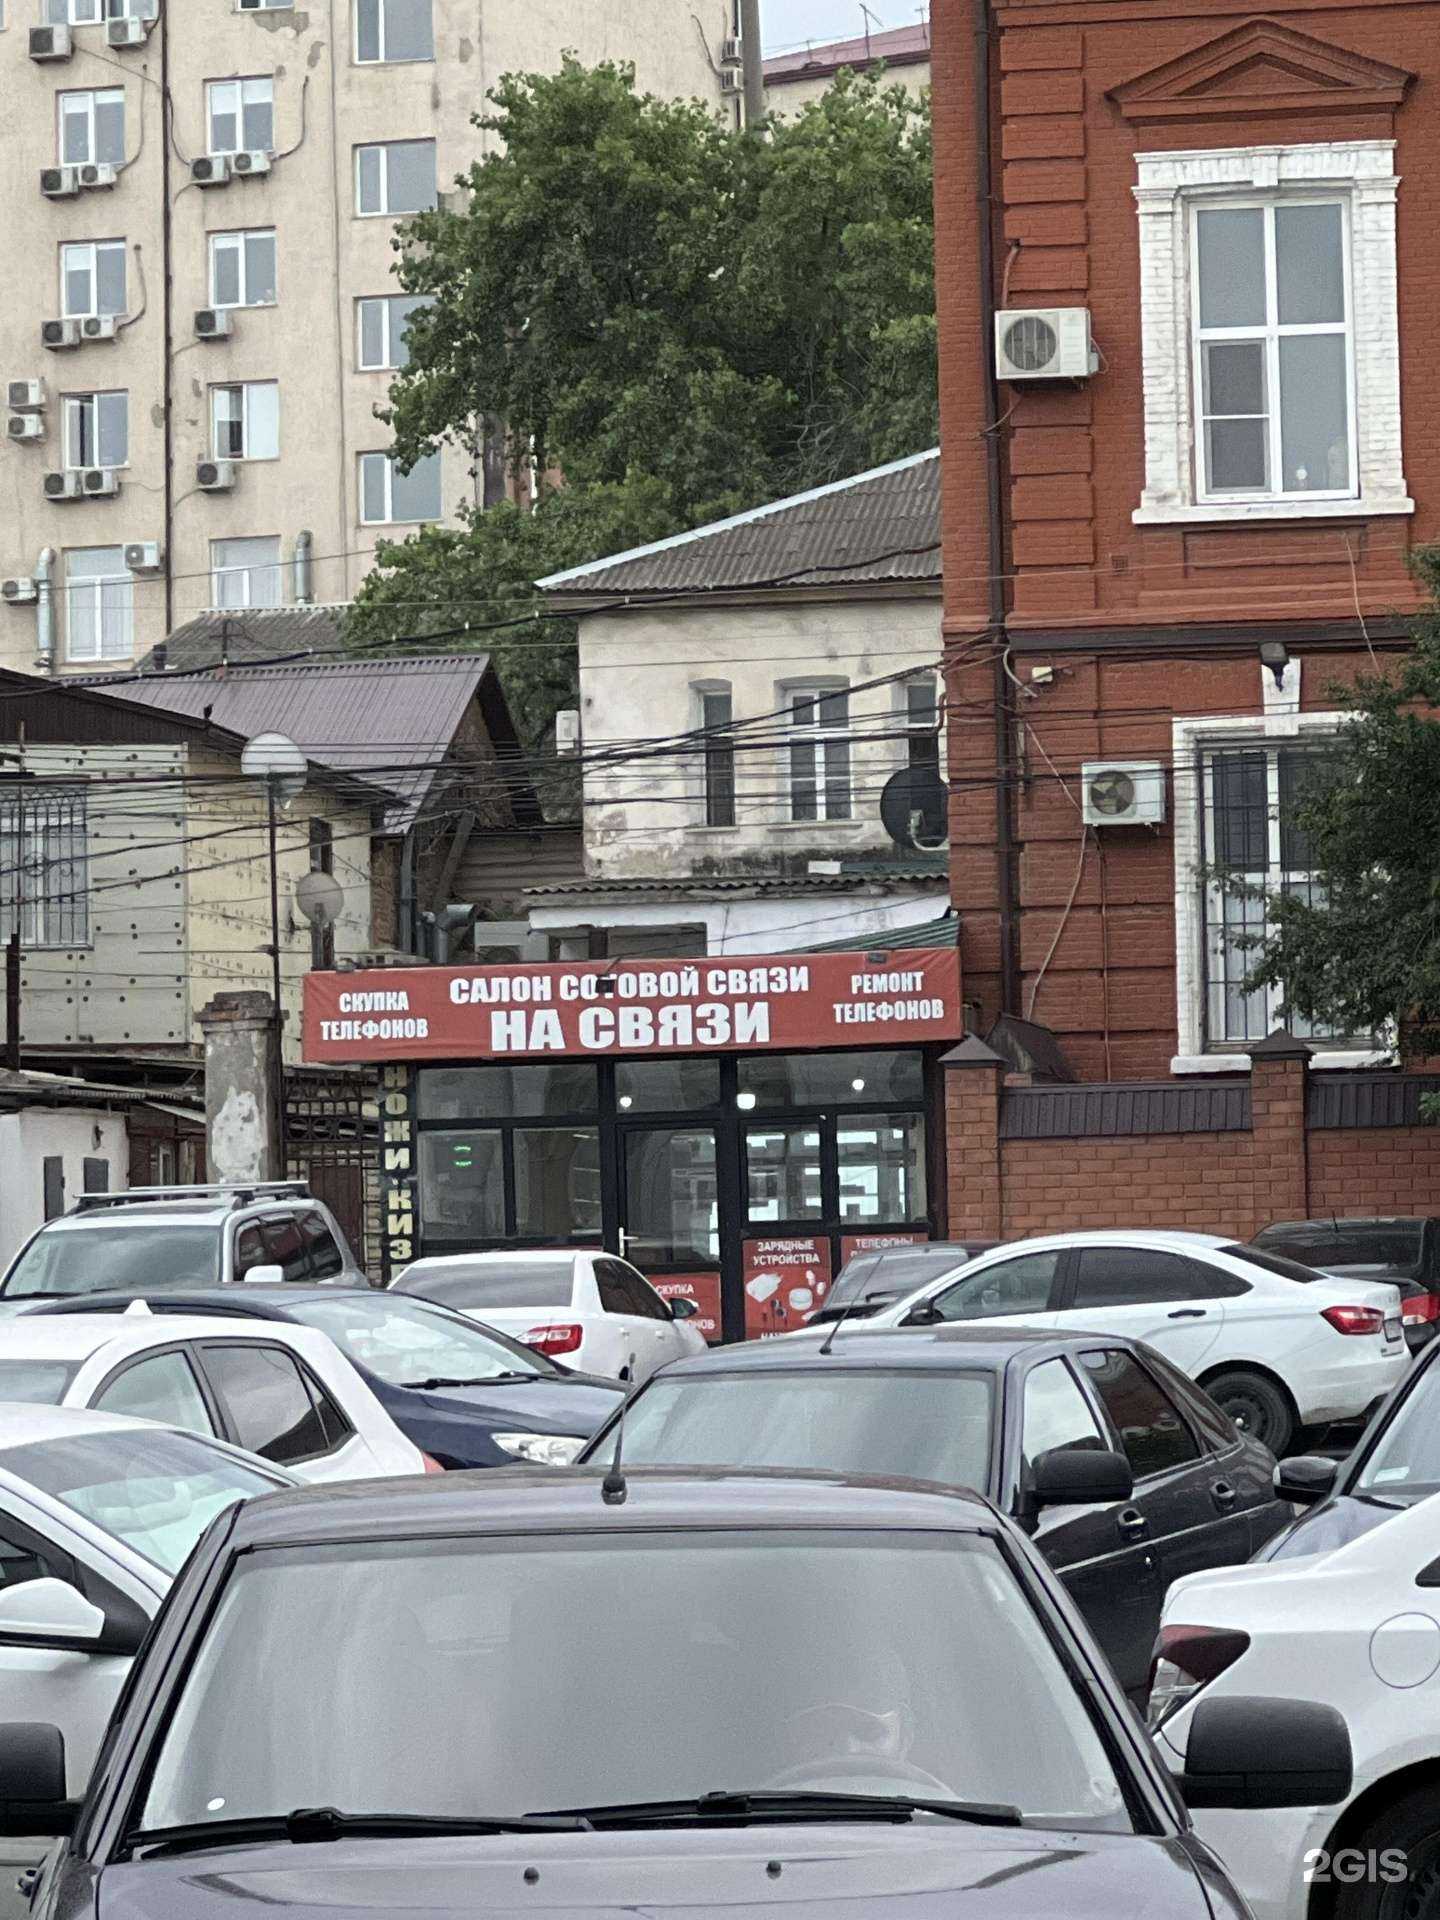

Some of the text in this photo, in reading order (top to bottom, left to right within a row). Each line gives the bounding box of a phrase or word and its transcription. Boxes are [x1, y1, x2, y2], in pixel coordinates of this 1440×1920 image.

[449, 975, 552, 1005] САЛОН
[706, 965, 810, 996] СВЯЗИ
[850, 971, 926, 995] РЕМОНТ
[337, 990, 410, 1013] СКУПКА
[832, 998, 945, 1025] ТЕЛЕФОНОВ
[319, 1017, 430, 1041] ТЕЛЕФОНОВ
[490, 1001, 771, 1052] НА СВЯЗИ
[753, 1252, 821, 1267] УСТРОЙСТВА
[757, 1239, 815, 1256] ЗАРЯДНЫЕ
